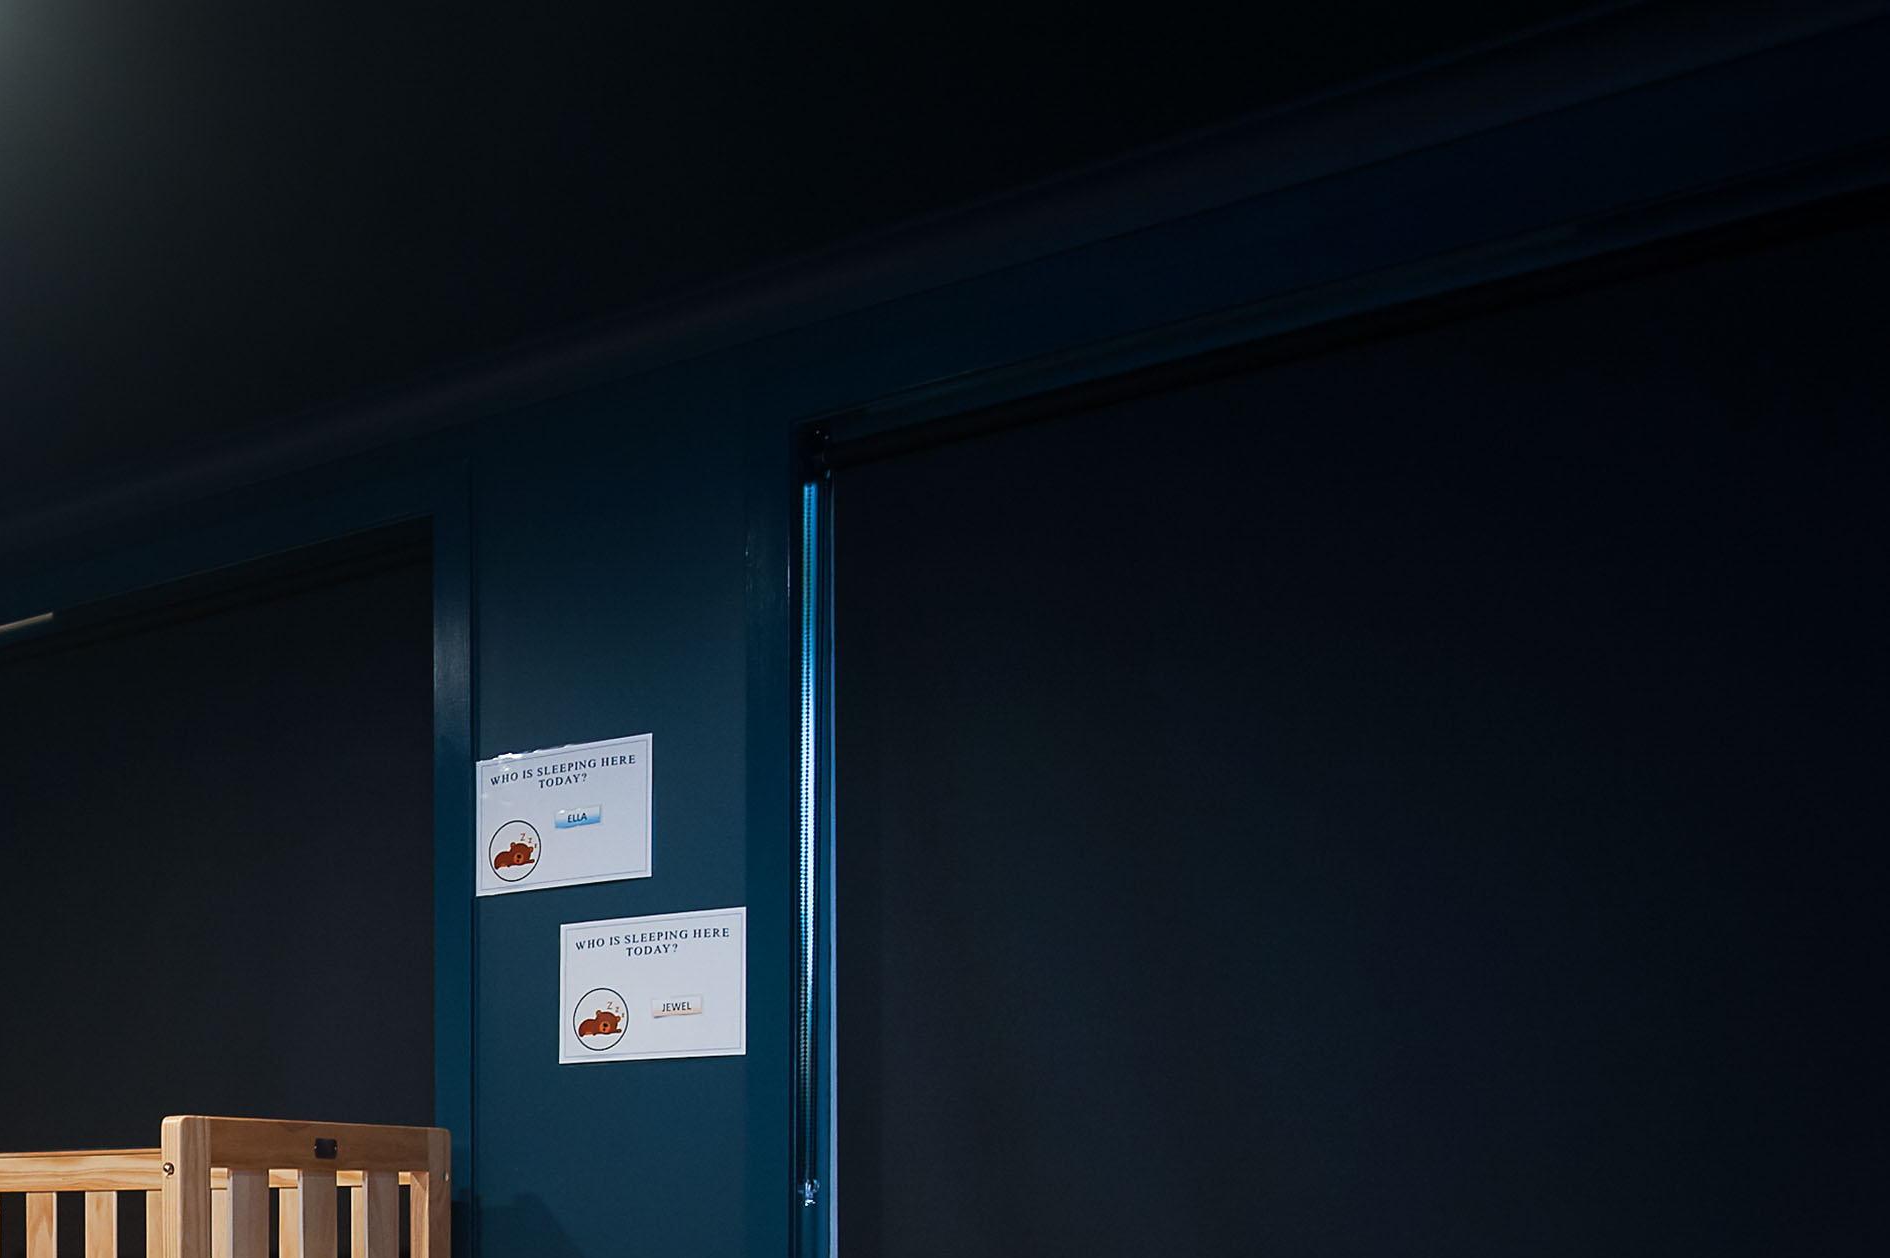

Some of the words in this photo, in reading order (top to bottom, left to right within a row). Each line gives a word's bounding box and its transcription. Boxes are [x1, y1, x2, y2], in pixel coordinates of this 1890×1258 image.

[490, 772, 519, 787] WHO
[522, 769, 533, 779] IS
[537, 759, 597, 777] SLEEPING
[601, 754, 636, 767] HERE
[538, 773, 588, 789] TODAY?
[567, 812, 588, 824] ELLA
[575, 938, 605, 951] WHO
[609, 935, 620, 946] IS
[624, 929, 689, 944] SLEEPING
[693, 927, 730, 938] HERE
[626, 943, 679, 957] TODAY?
[662, 1001, 692, 1013] JEWEL
